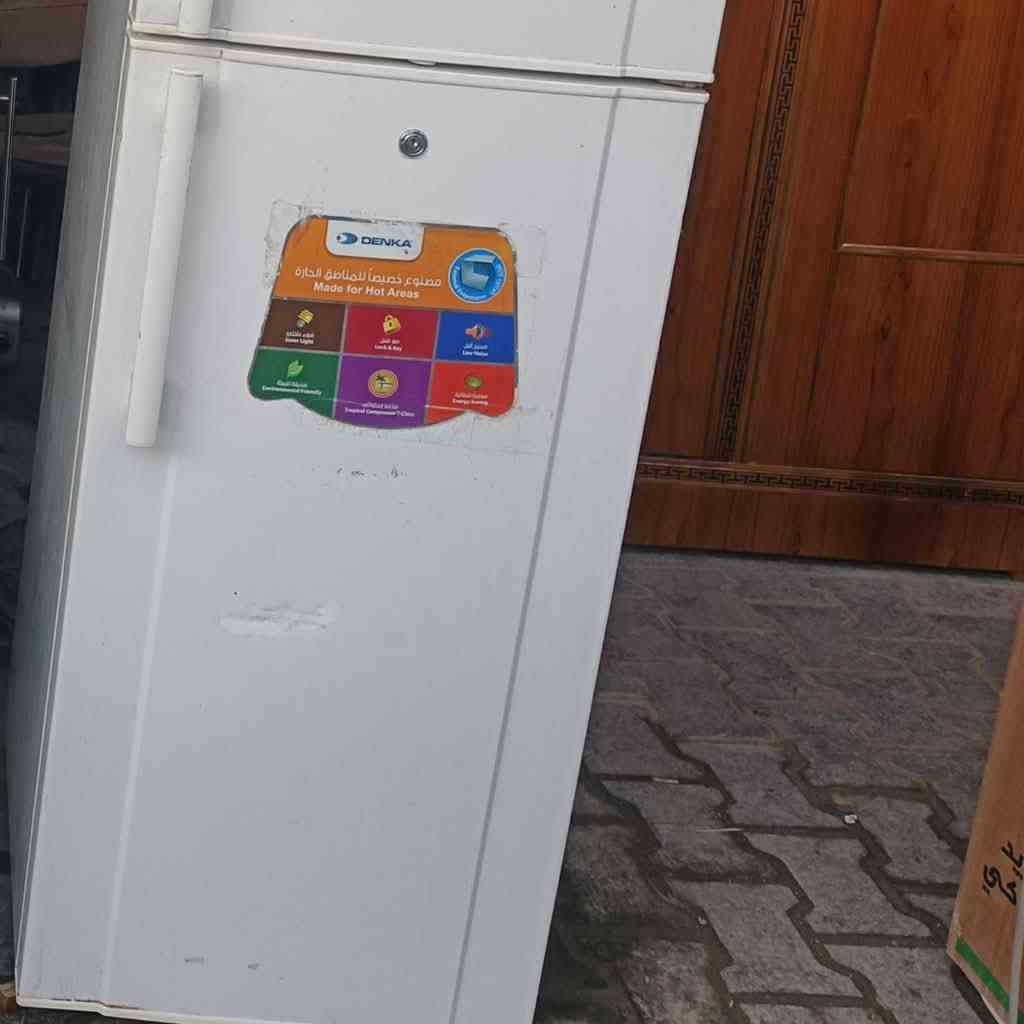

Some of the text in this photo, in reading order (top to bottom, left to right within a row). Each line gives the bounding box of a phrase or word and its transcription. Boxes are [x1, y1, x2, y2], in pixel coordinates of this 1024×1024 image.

[361, 236, 412, 248] DENKA
[313, 282, 420, 299] Made for Hot Areas
